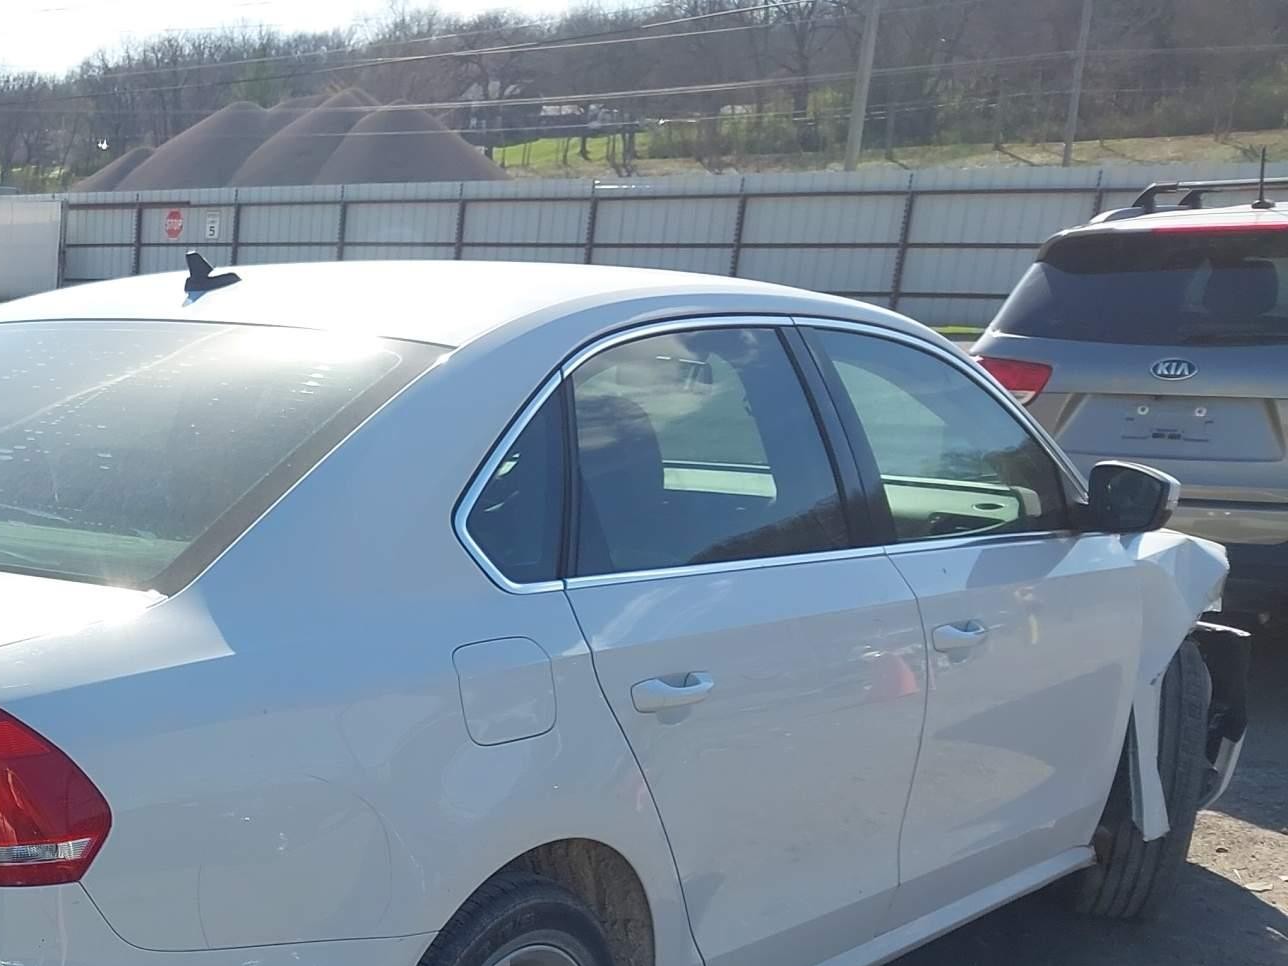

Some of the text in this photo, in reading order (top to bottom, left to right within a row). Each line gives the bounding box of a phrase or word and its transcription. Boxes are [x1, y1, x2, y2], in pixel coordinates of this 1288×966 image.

[166, 218, 183, 231] STOP
[208, 225, 215, 237] 5
[1157, 362, 1190, 376] KIA
